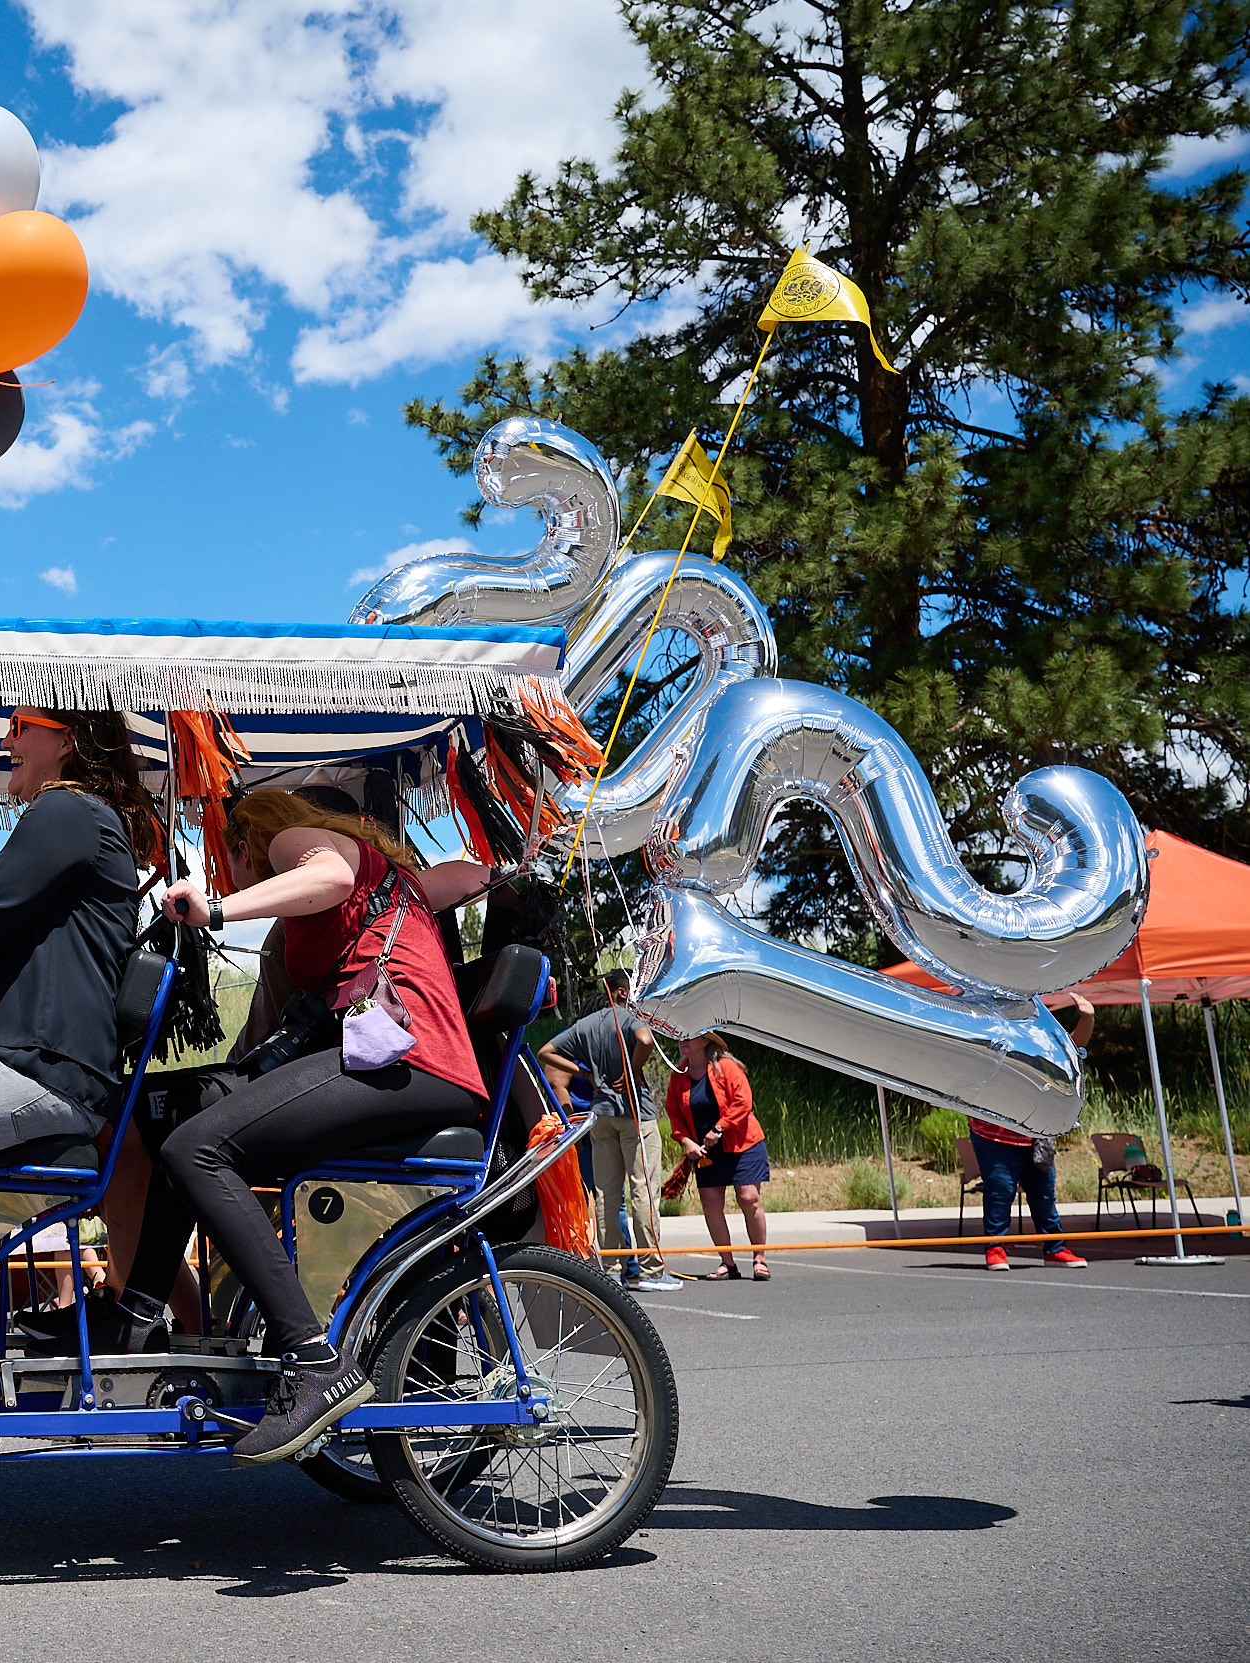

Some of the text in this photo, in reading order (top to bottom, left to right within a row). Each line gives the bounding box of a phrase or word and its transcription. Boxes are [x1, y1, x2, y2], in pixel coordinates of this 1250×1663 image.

[782, 266, 824, 281] WHEEL
[320, 1196, 334, 1215] 7
[323, 1369, 363, 1405] NOBULL
